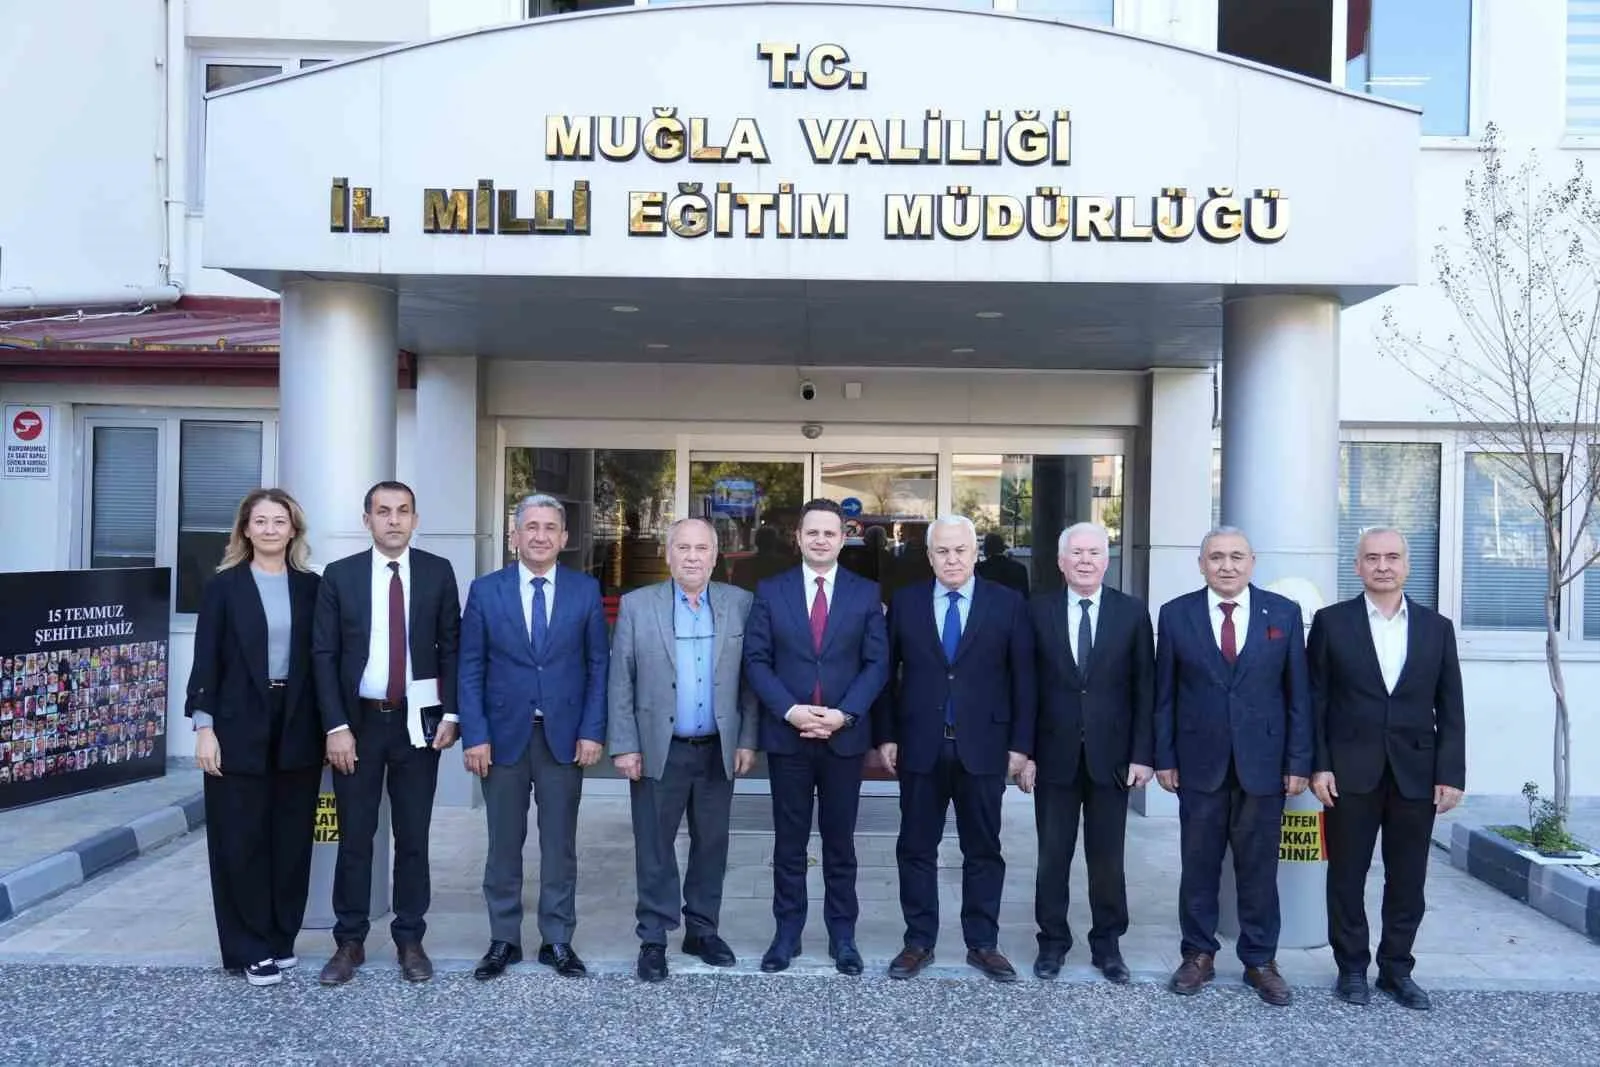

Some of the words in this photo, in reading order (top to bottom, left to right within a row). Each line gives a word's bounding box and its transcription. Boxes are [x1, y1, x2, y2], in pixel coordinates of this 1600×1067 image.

[758, 43, 867, 89] T.C.
[545, 106, 770, 163] MUĞLA
[799, 109, 1072, 165] VALİLİĞİ
[330, 177, 390, 233] İL
[424, 179, 592, 235] MİLLİ
[628, 182, 848, 238] EĞİTİM
[885, 185, 1290, 244] MÜDÜRLÜĞÜ
[35, 621, 133, 646] ŞEHİTLERİMİZ
[48, 609, 61, 622] 15
[65, 605, 124, 621] TEMMUZ
